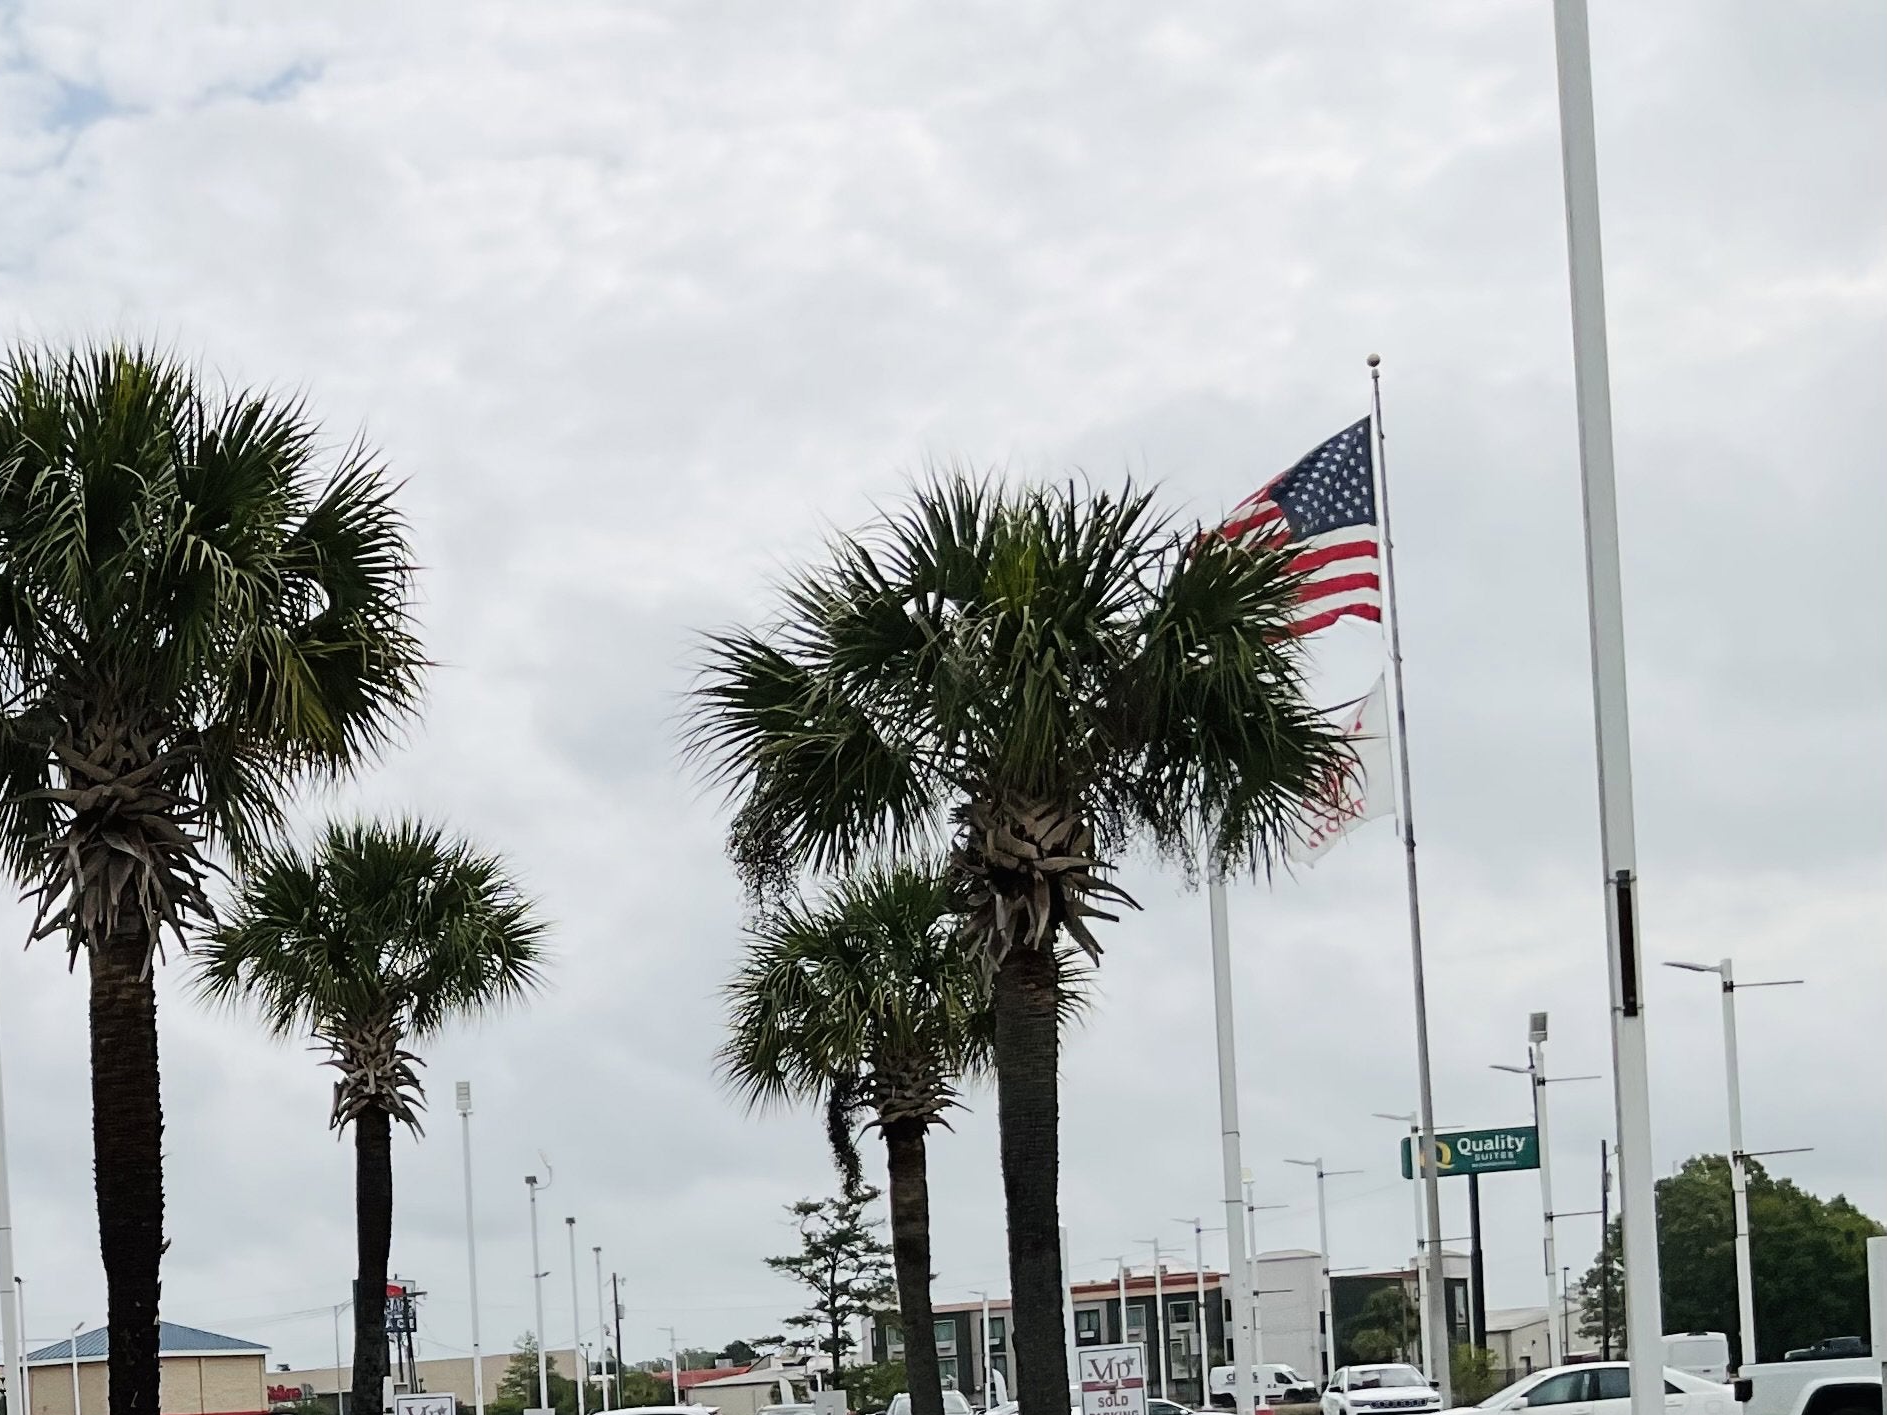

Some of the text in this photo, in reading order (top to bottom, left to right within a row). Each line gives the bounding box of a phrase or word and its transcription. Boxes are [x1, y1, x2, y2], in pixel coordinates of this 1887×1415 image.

[1457, 1134, 1526, 1156] Quality
[1475, 1151, 1514, 1162] SUITES
[1098, 1396, 1128, 1408] SOLD
